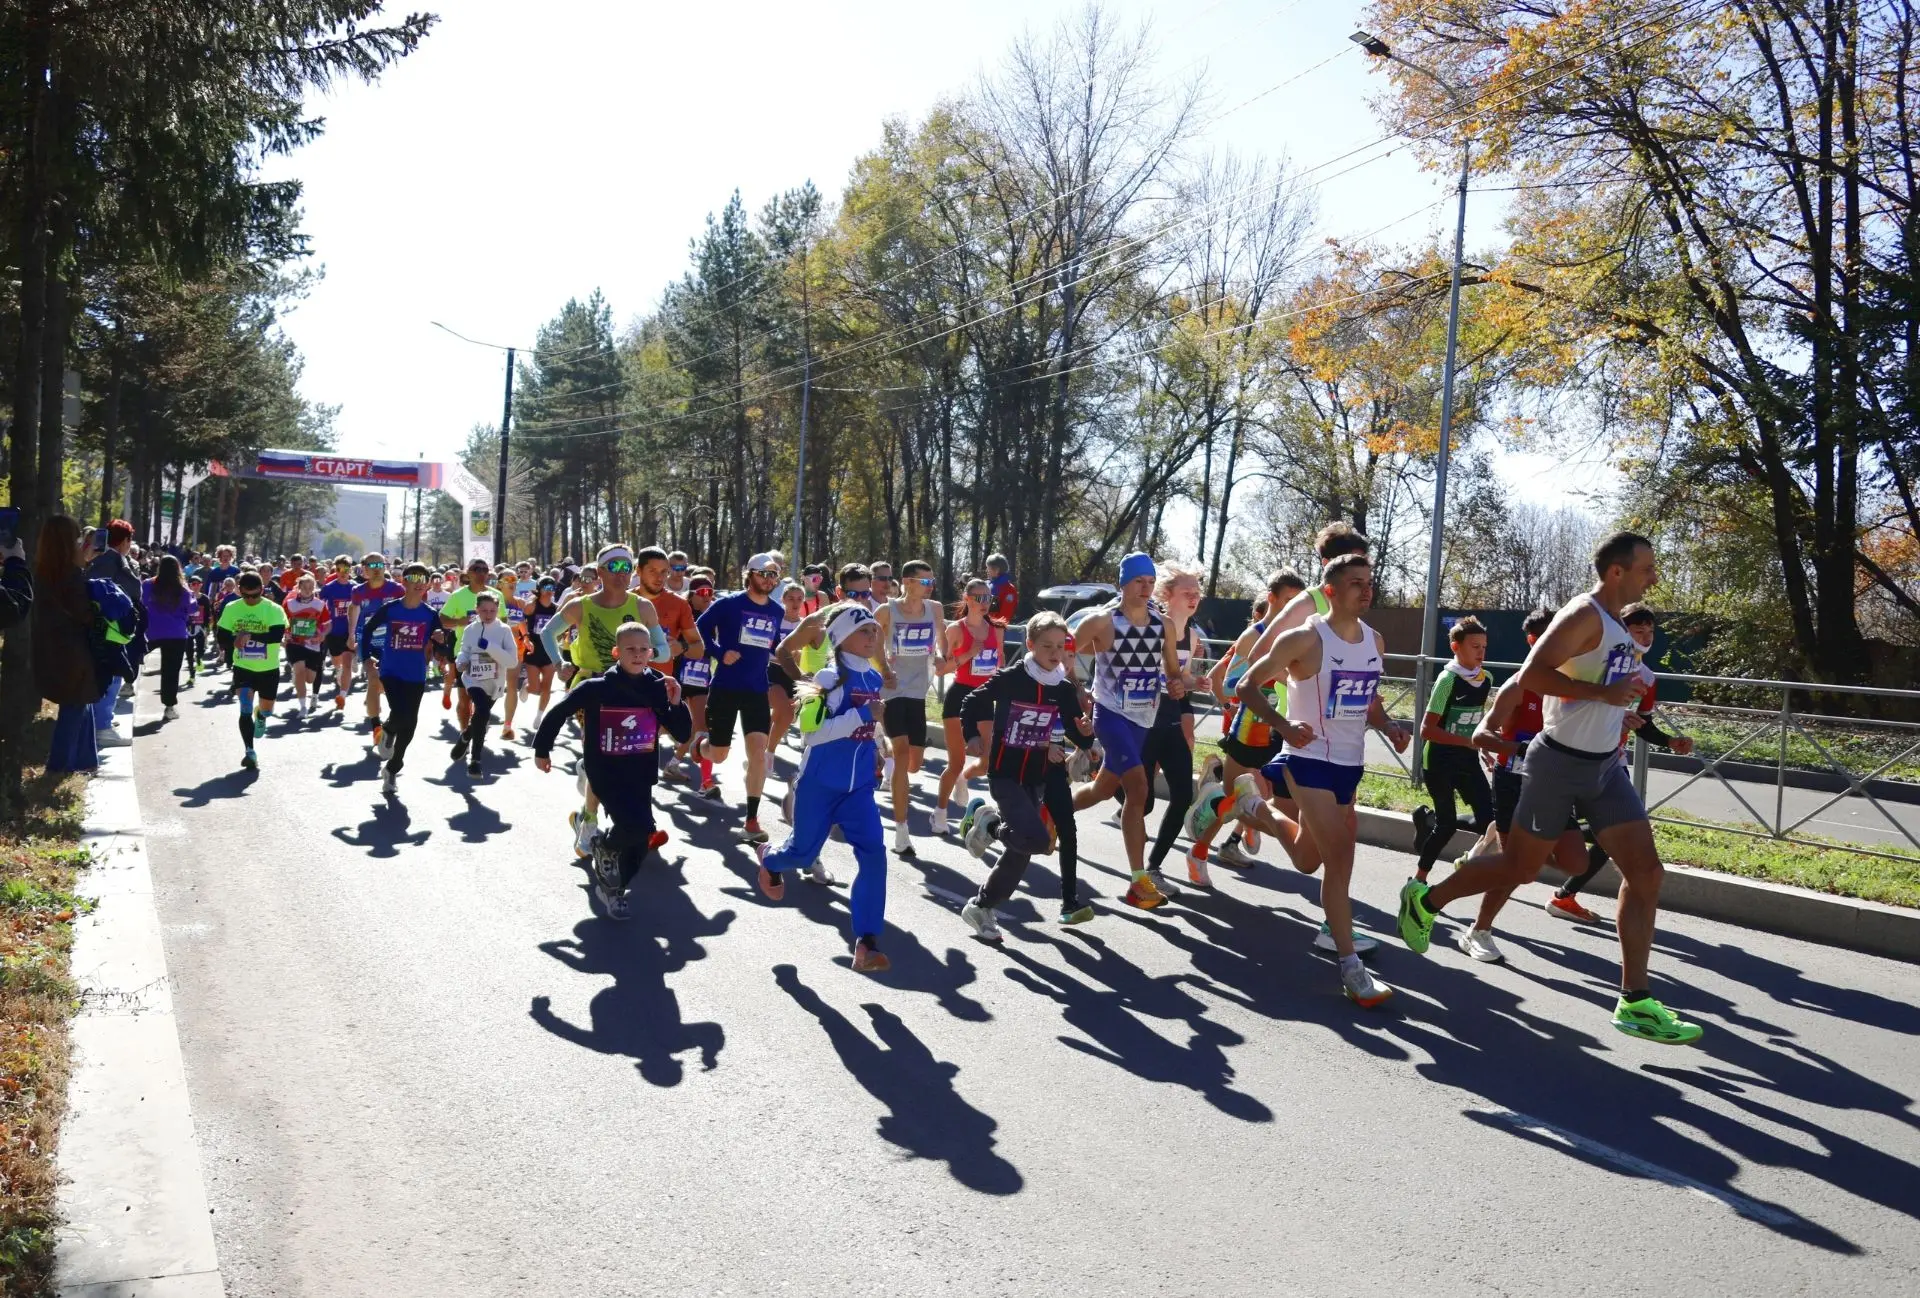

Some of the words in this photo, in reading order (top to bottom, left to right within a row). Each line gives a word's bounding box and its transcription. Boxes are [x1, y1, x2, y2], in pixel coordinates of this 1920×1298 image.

[315, 461, 365, 476] СТАРТ
[399, 625, 418, 636] 41
[746, 617, 773, 632] 151
[1123, 678, 1157, 691] 312
[621, 714, 637, 730] 4
[1019, 710, 1052, 727] 29
